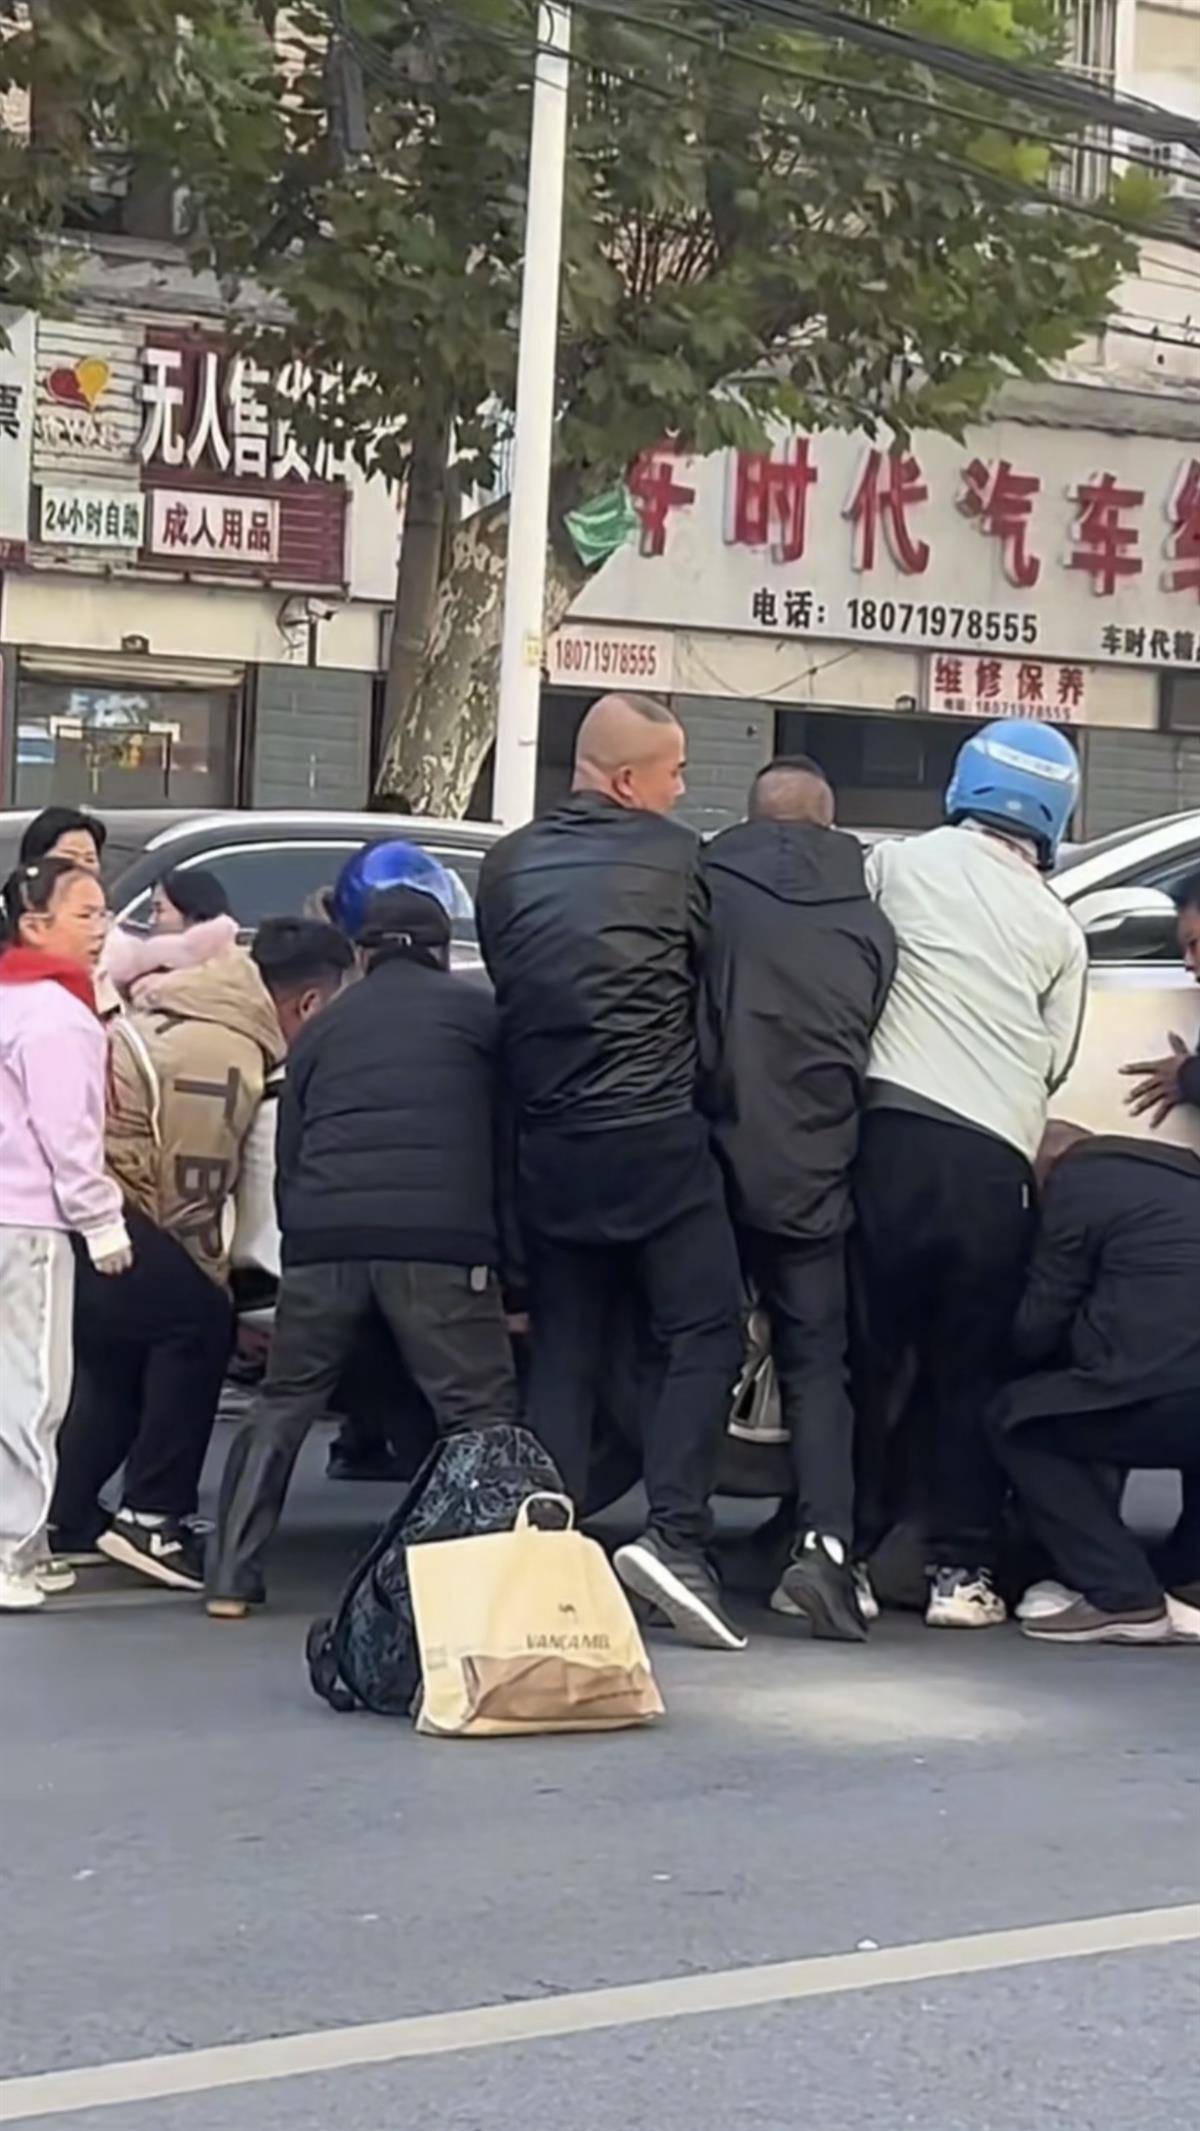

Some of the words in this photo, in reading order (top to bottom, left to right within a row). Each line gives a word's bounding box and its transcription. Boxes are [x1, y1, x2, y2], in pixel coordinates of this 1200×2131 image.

[163, 501, 271, 552] 成人用品
[848, 598, 1038, 644] 18071978555
[556, 638, 657, 675] 18071978555
[934, 656, 1085, 706] 维修保养
